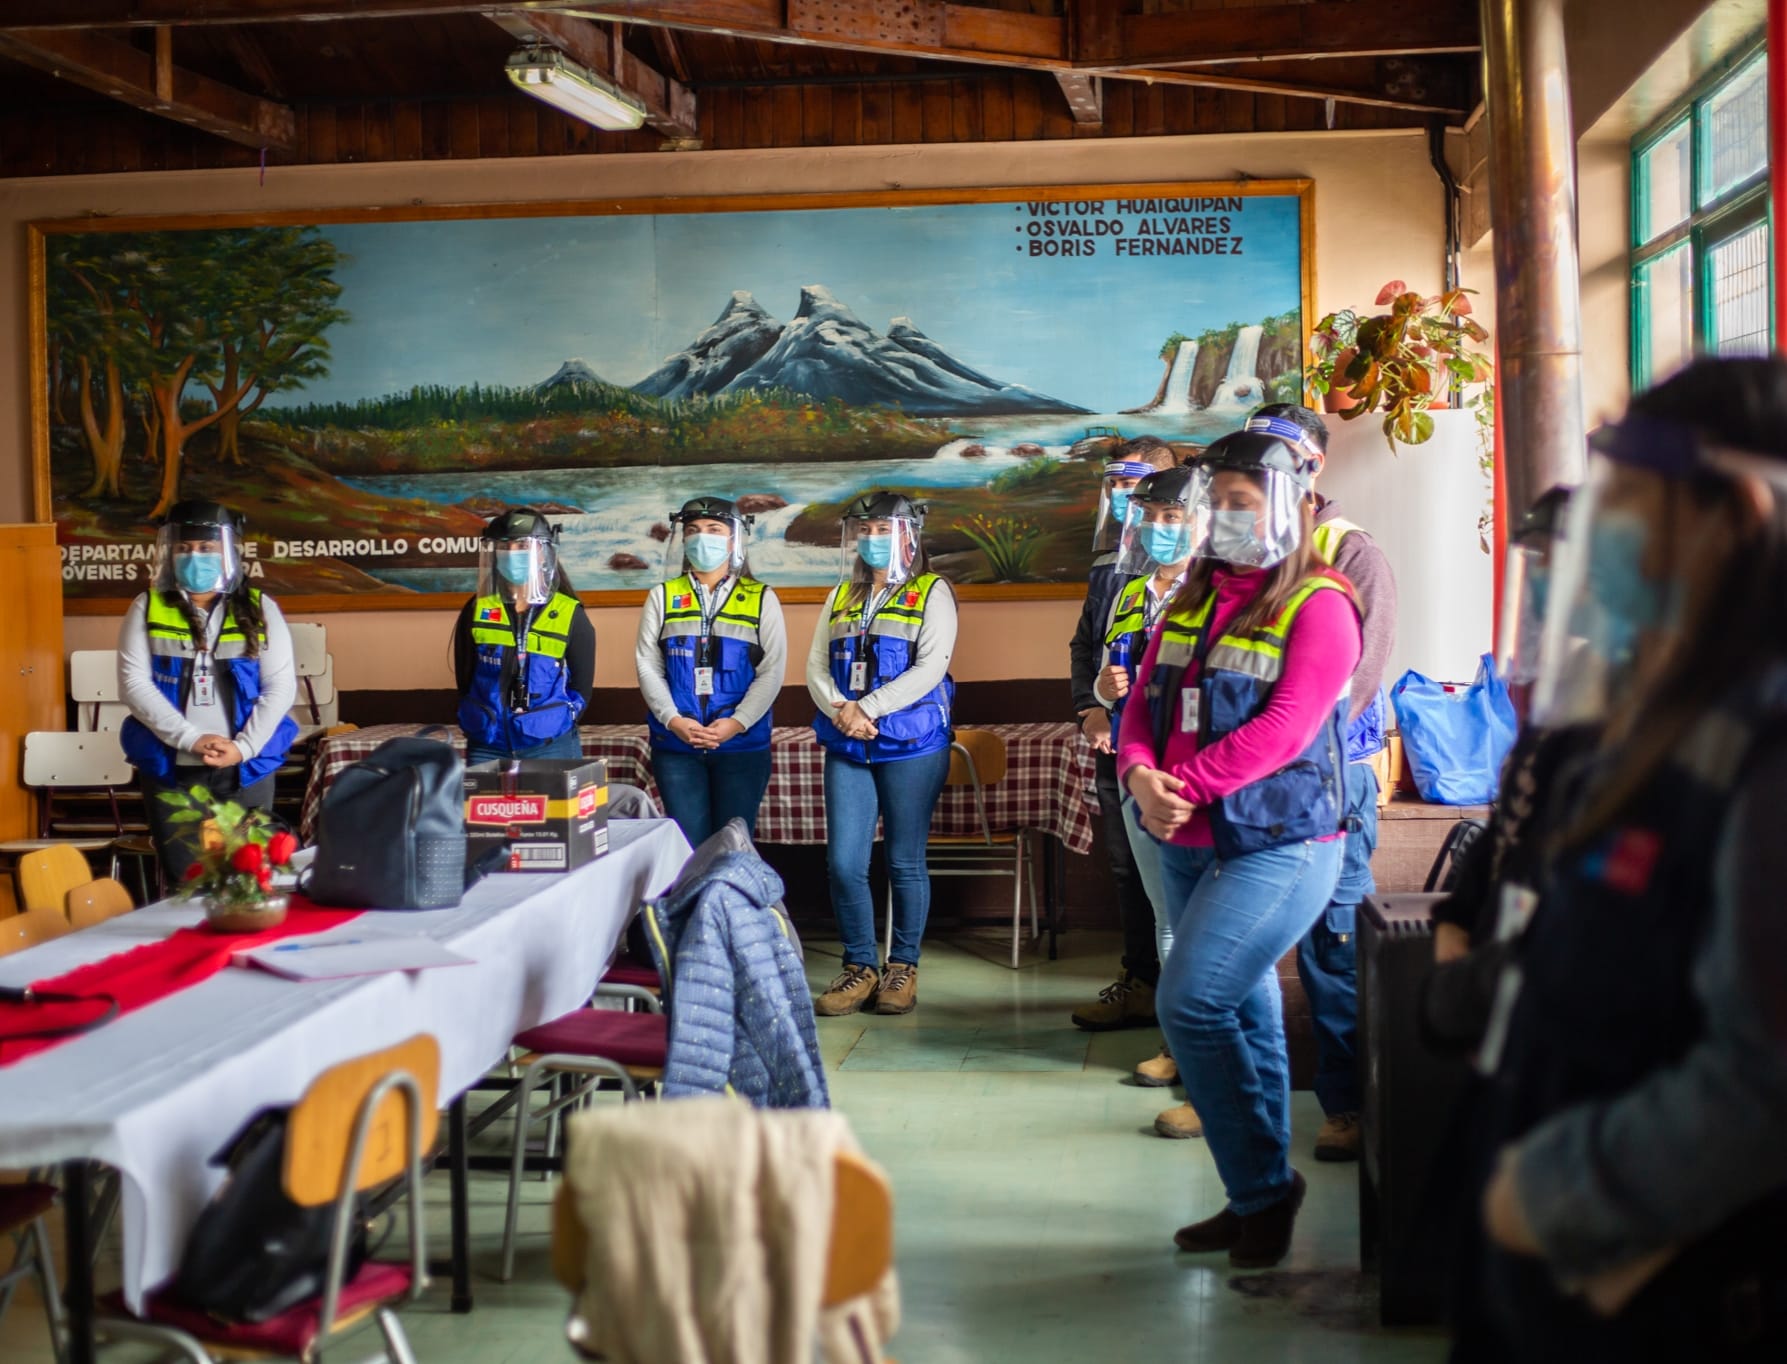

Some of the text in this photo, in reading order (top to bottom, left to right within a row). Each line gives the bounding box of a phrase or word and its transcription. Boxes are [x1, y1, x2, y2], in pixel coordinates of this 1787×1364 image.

[1027, 198, 1243, 216] VICTOR HUAIQUIPAN
[1026, 217, 1231, 236] OSVALDO ALVARES
[1029, 237, 1243, 256] BORIS FERNANDEZ
[60, 543, 168, 561] DEPARTAM
[273, 538, 408, 558] DESARROLLO
[418, 536, 494, 553] COMUN
[62, 561, 138, 580] ÓVENES
[477, 800, 538, 817] CUSQUEÑA
